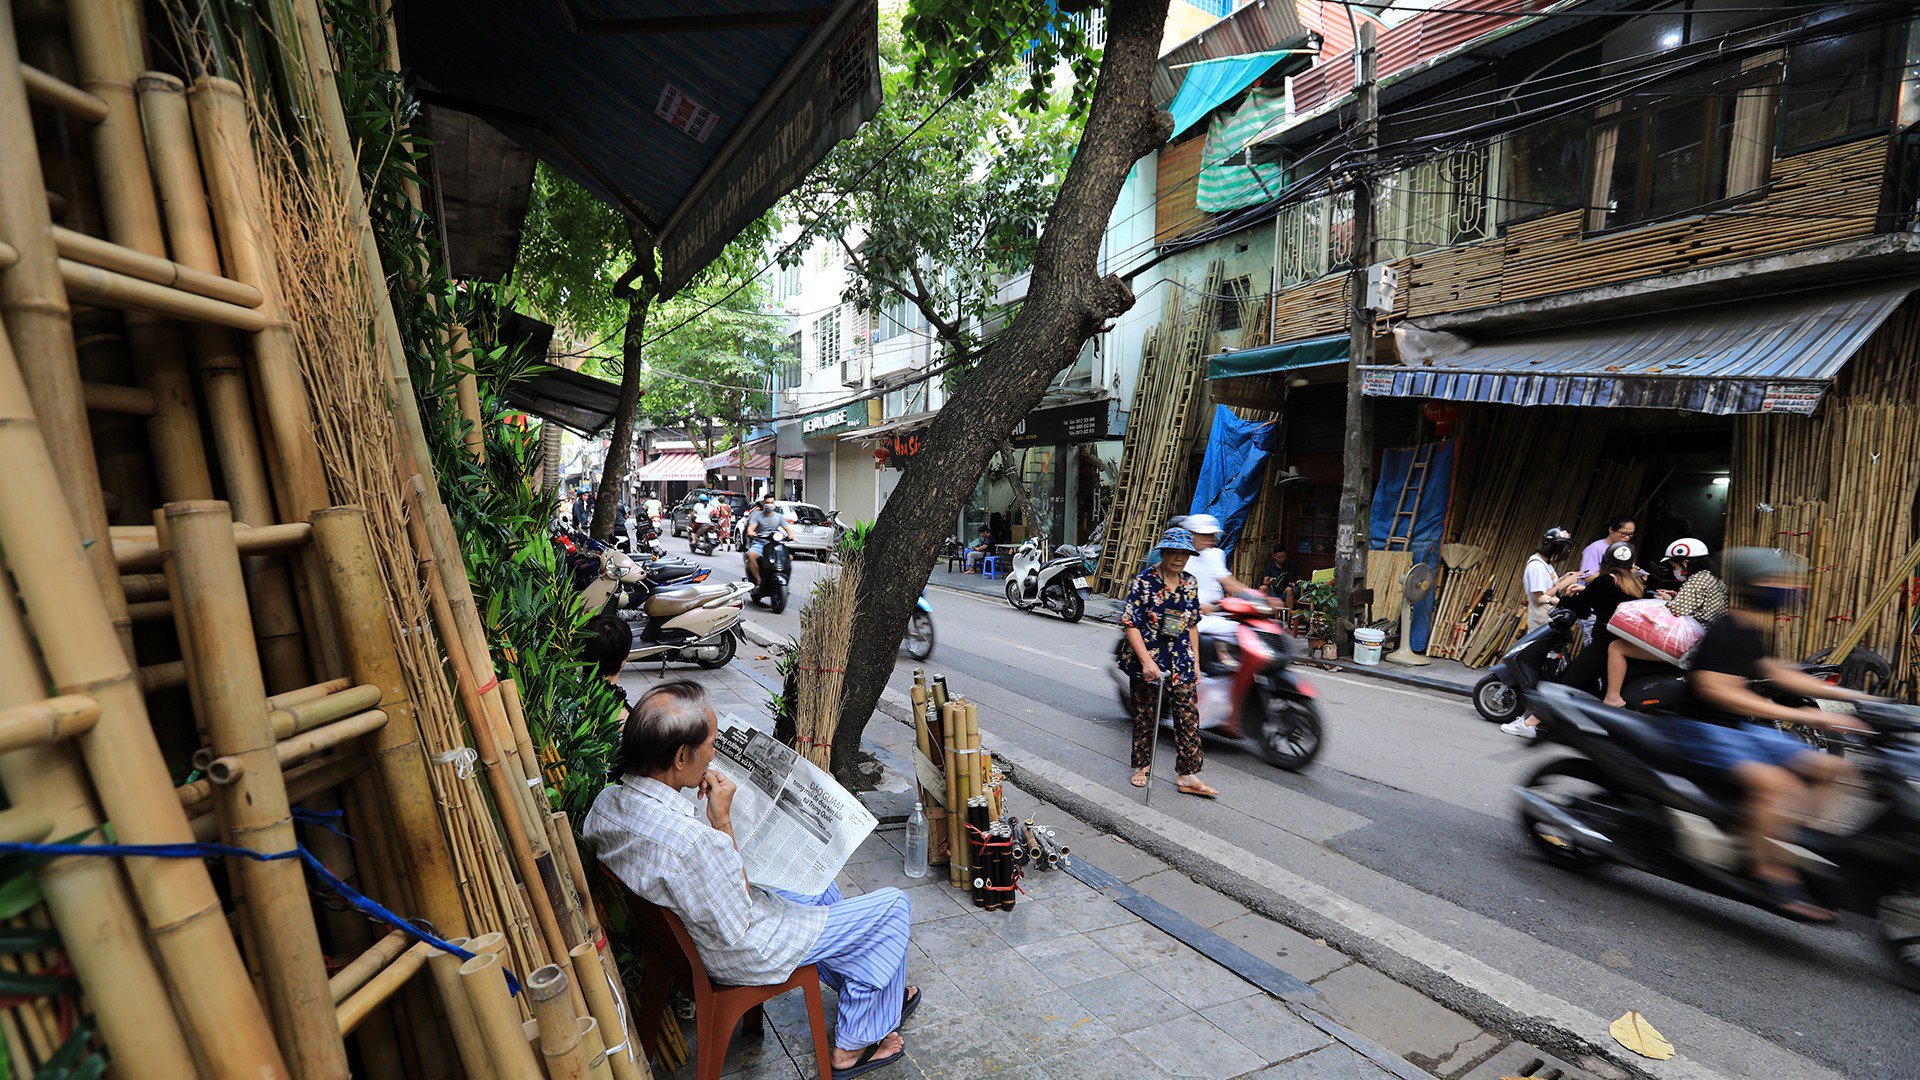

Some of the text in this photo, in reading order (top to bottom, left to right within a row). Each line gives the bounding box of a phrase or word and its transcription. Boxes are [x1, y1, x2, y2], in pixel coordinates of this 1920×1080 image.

[793, 779, 806, 795] trong
[822, 791, 845, 811] GUAM
[808, 801, 822, 817] Trung
[820, 809, 833, 824] Quốc
